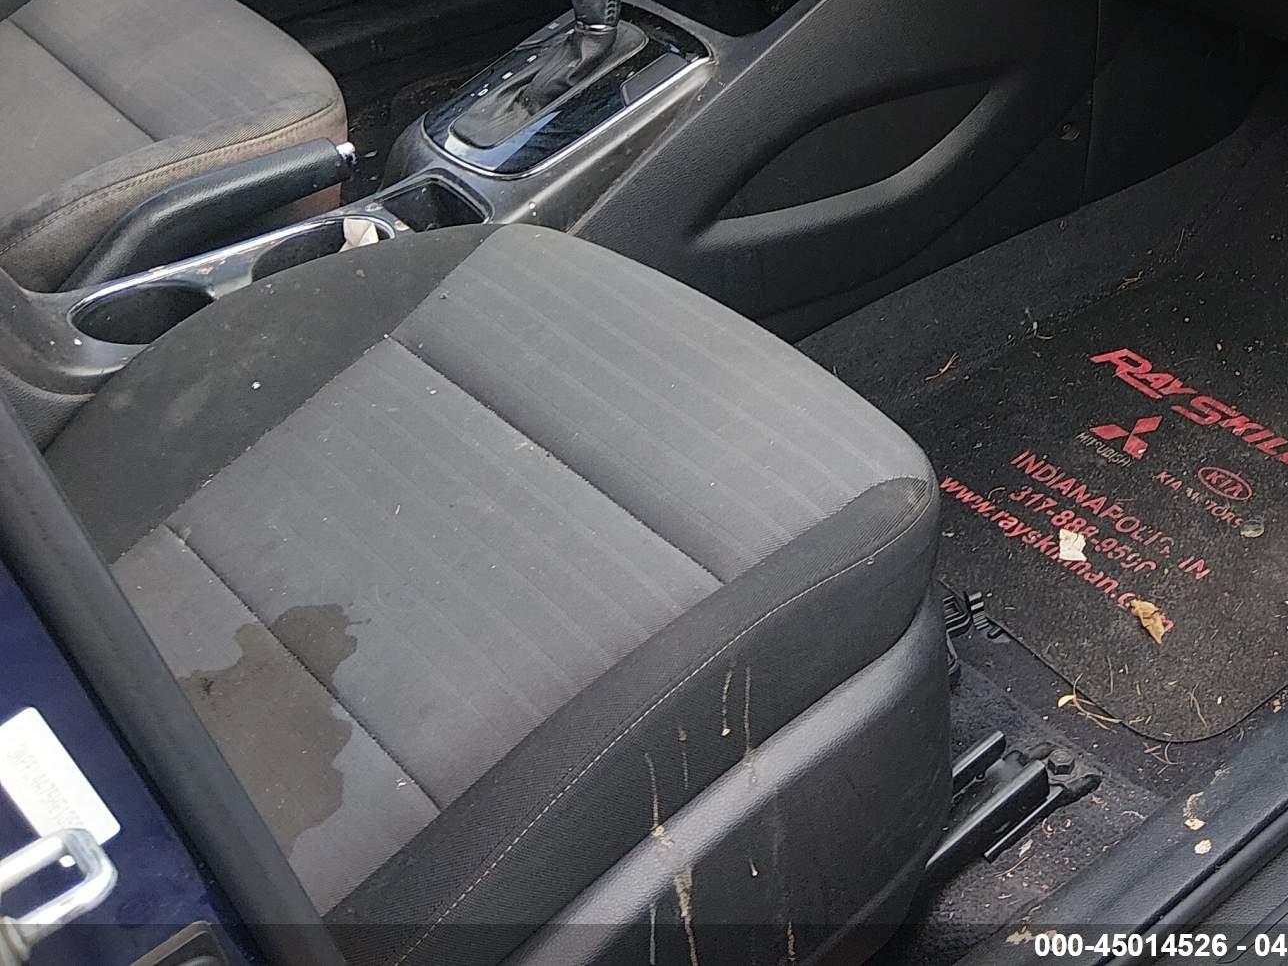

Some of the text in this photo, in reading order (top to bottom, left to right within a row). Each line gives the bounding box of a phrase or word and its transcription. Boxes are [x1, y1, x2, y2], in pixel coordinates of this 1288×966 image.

[1089, 348, 1198, 400] RAY
[1154, 471, 1245, 529] KIA MTORS
[1204, 469, 1246, 498] KIA
[1178, 554, 1211, 581] IN
